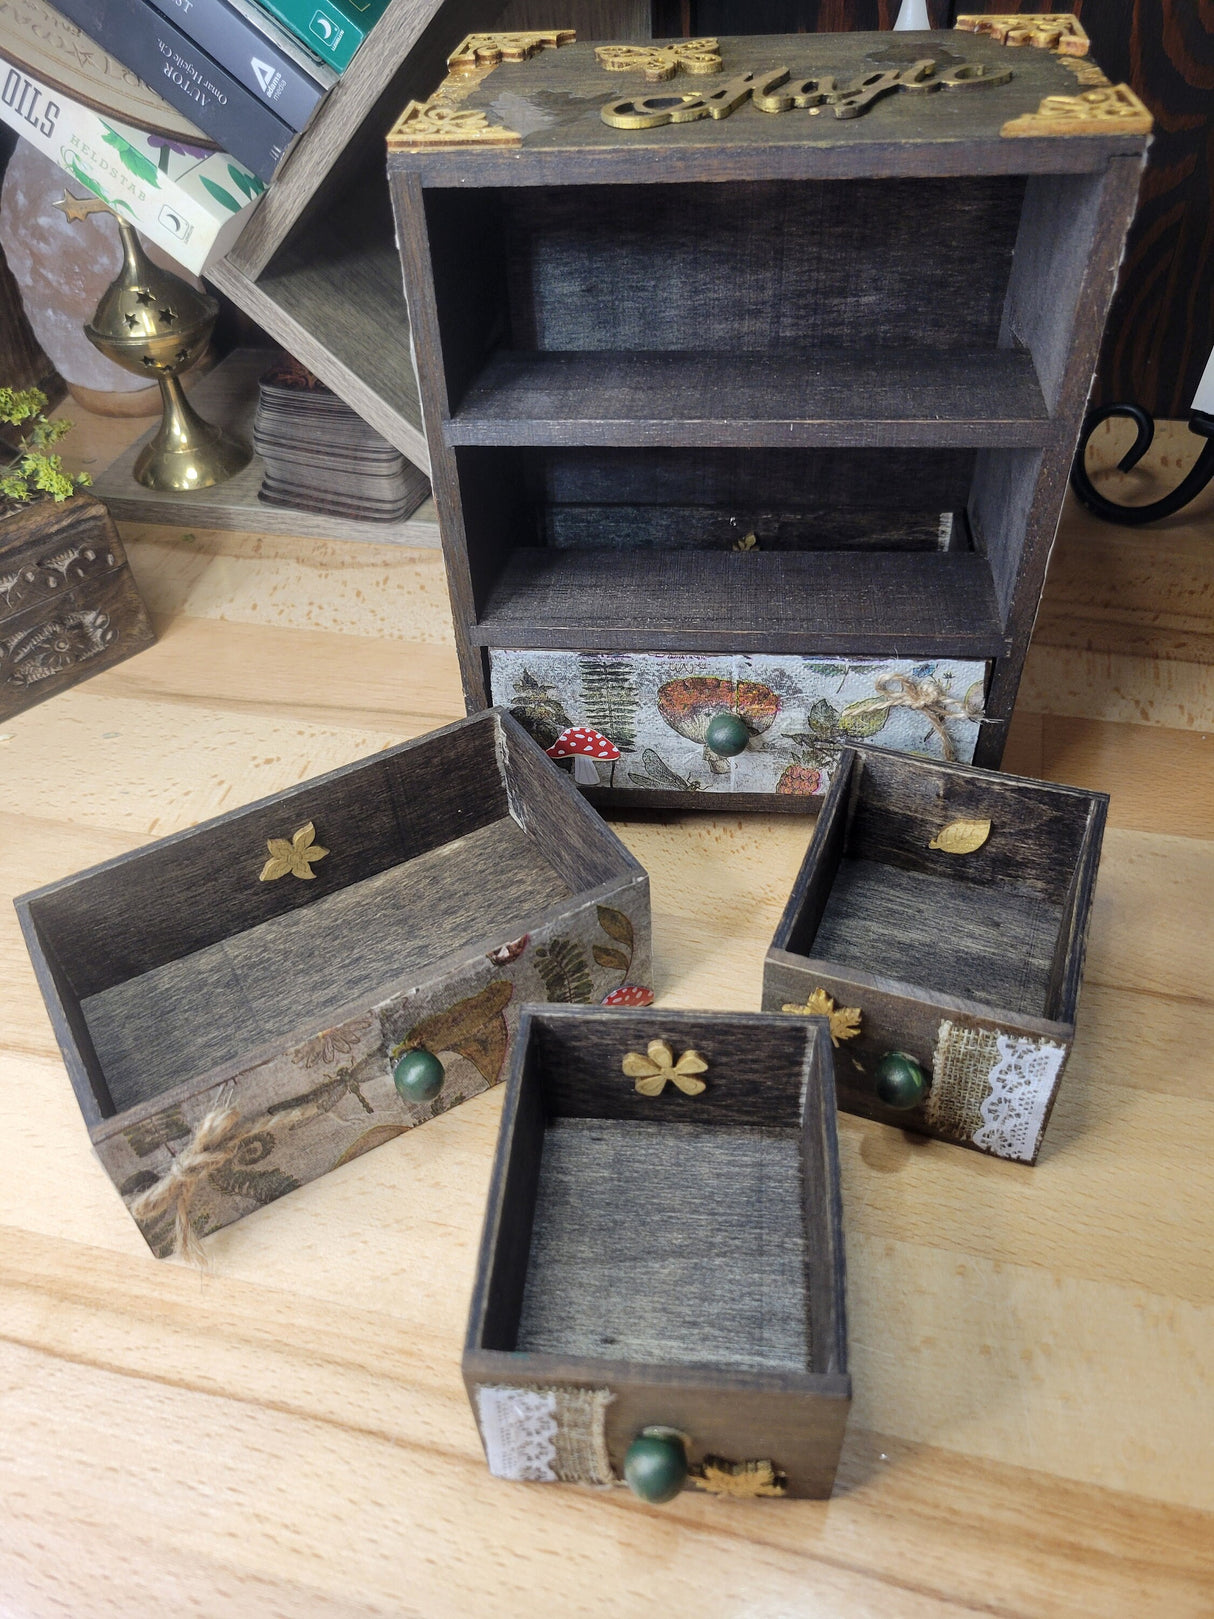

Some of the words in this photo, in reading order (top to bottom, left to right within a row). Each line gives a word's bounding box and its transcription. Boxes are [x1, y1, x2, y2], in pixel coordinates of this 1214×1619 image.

[157, 38, 173, 58] Ch.
[163, 62, 211, 106] AUTOR
[174, 54, 203, 84] Hejeile
[266, 72, 282, 98] adams
[1, 68, 61, 139] OILS
[203, 82, 228, 105] Omar
[600, 59, 1014, 130] Magic
[69, 134, 147, 202] HELDSTAB
